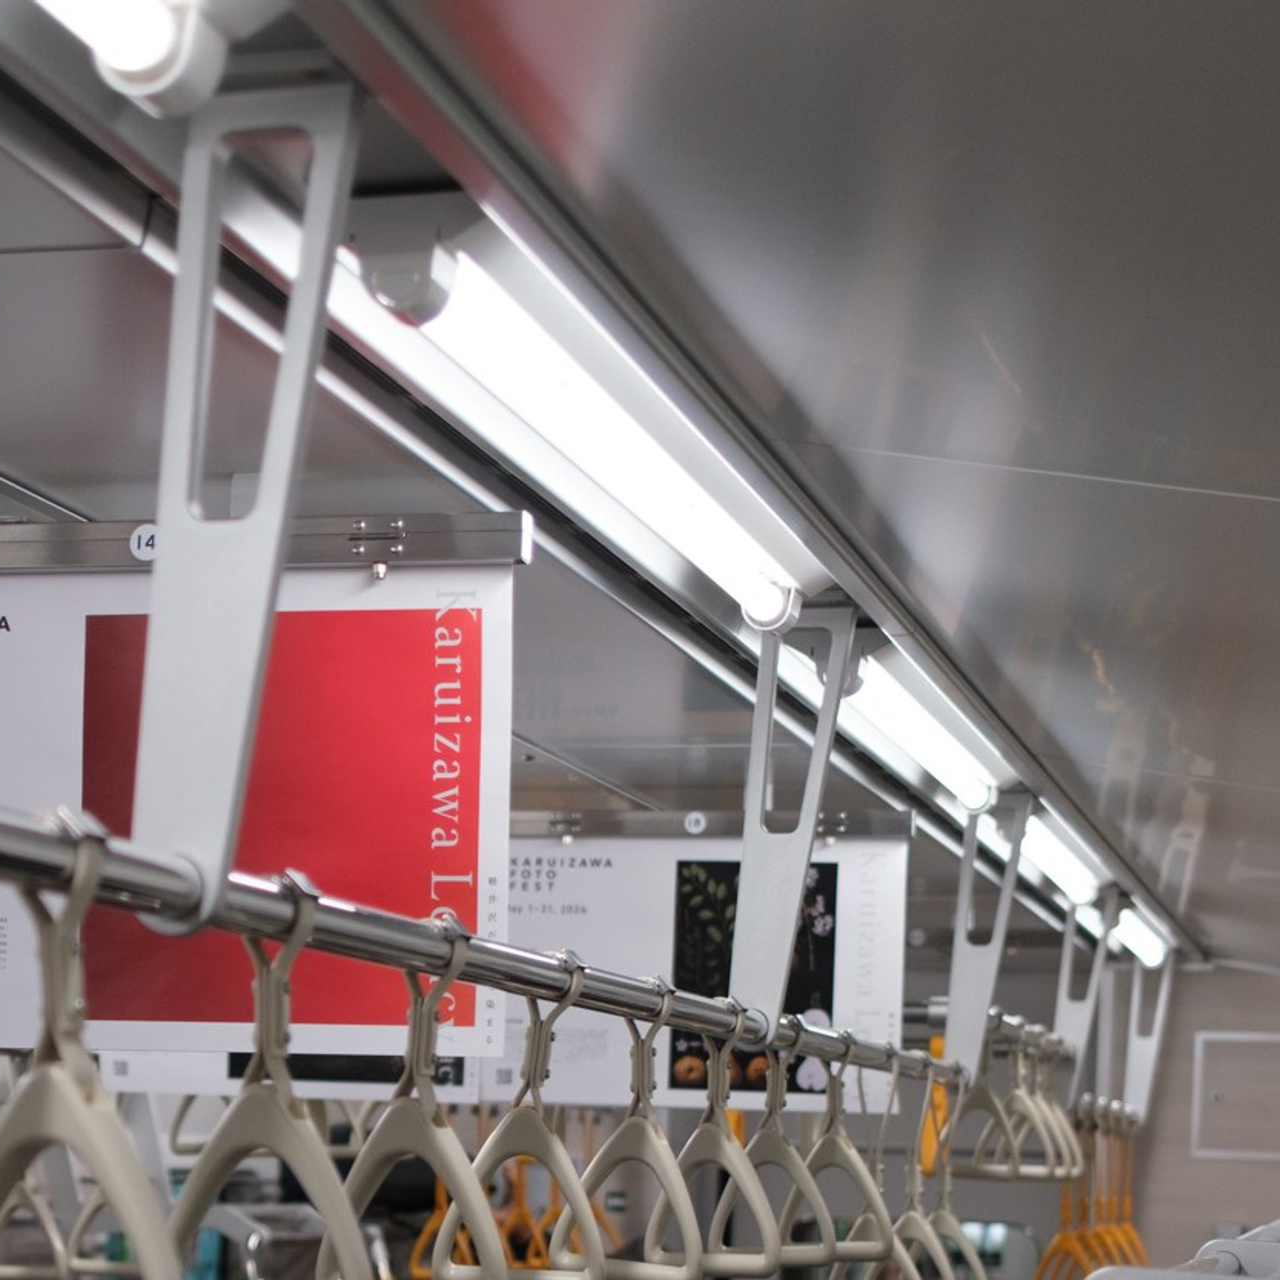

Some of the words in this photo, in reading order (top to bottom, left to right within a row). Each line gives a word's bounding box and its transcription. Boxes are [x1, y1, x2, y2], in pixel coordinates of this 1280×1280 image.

[137, 534, 155, 550] 14
[431, 587, 476, 849] Karuizawa
[510, 857, 613, 868] KARUIZAWA
[509, 869, 557, 880] FOTO
[508, 881, 555, 892] FEST
